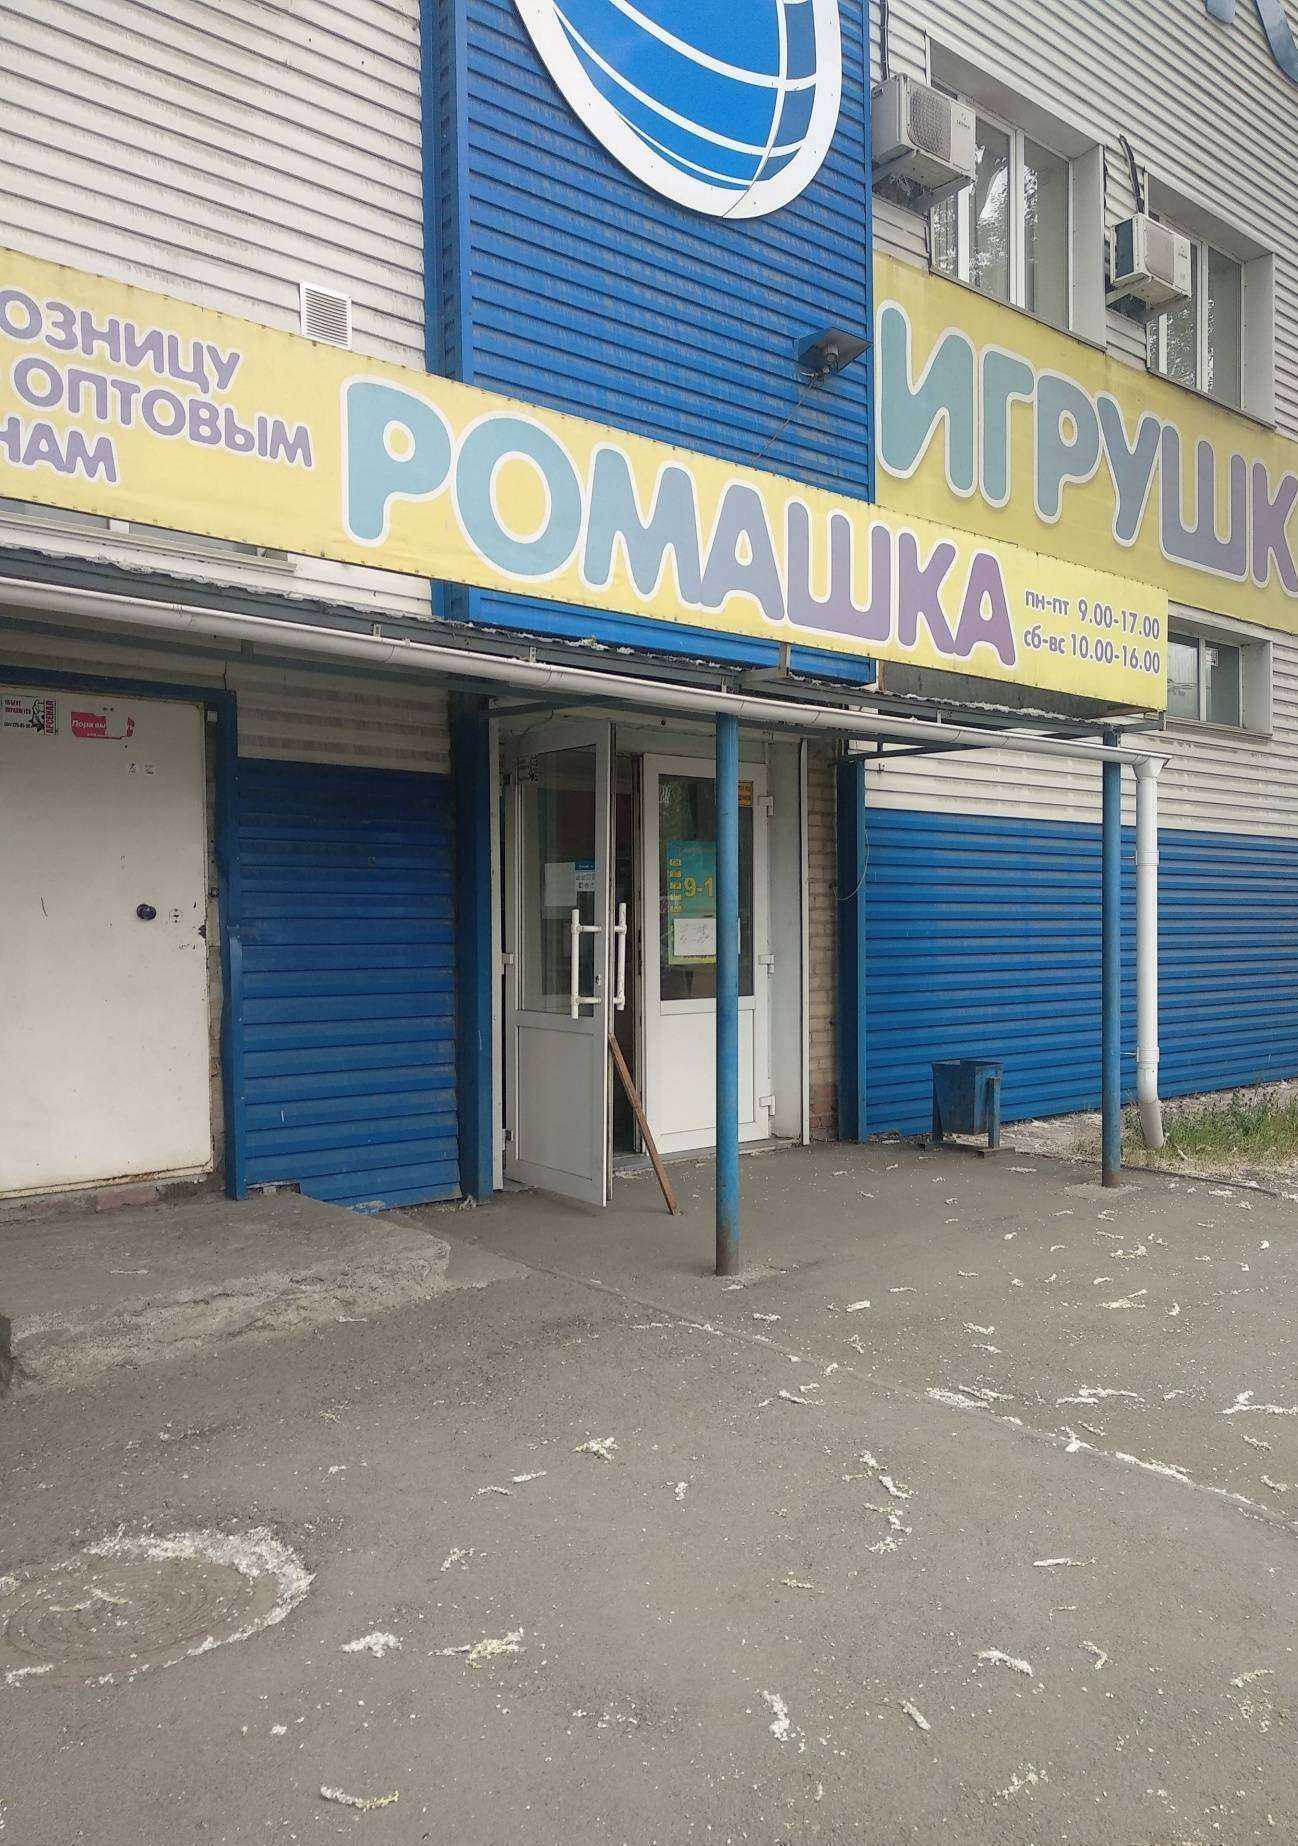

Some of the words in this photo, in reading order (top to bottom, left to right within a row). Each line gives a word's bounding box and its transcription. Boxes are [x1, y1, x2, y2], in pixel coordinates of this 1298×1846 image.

[0, 289, 241, 394] ОЗНИЦУ
[13, 357, 313, 468] ОПТОВЫМ
[344, 379, 1018, 669] РОМАШКА
[1070, 633, 1161, 674] 10.00-16.00
[1077, 598, 1160, 640] 9.00-17.00
